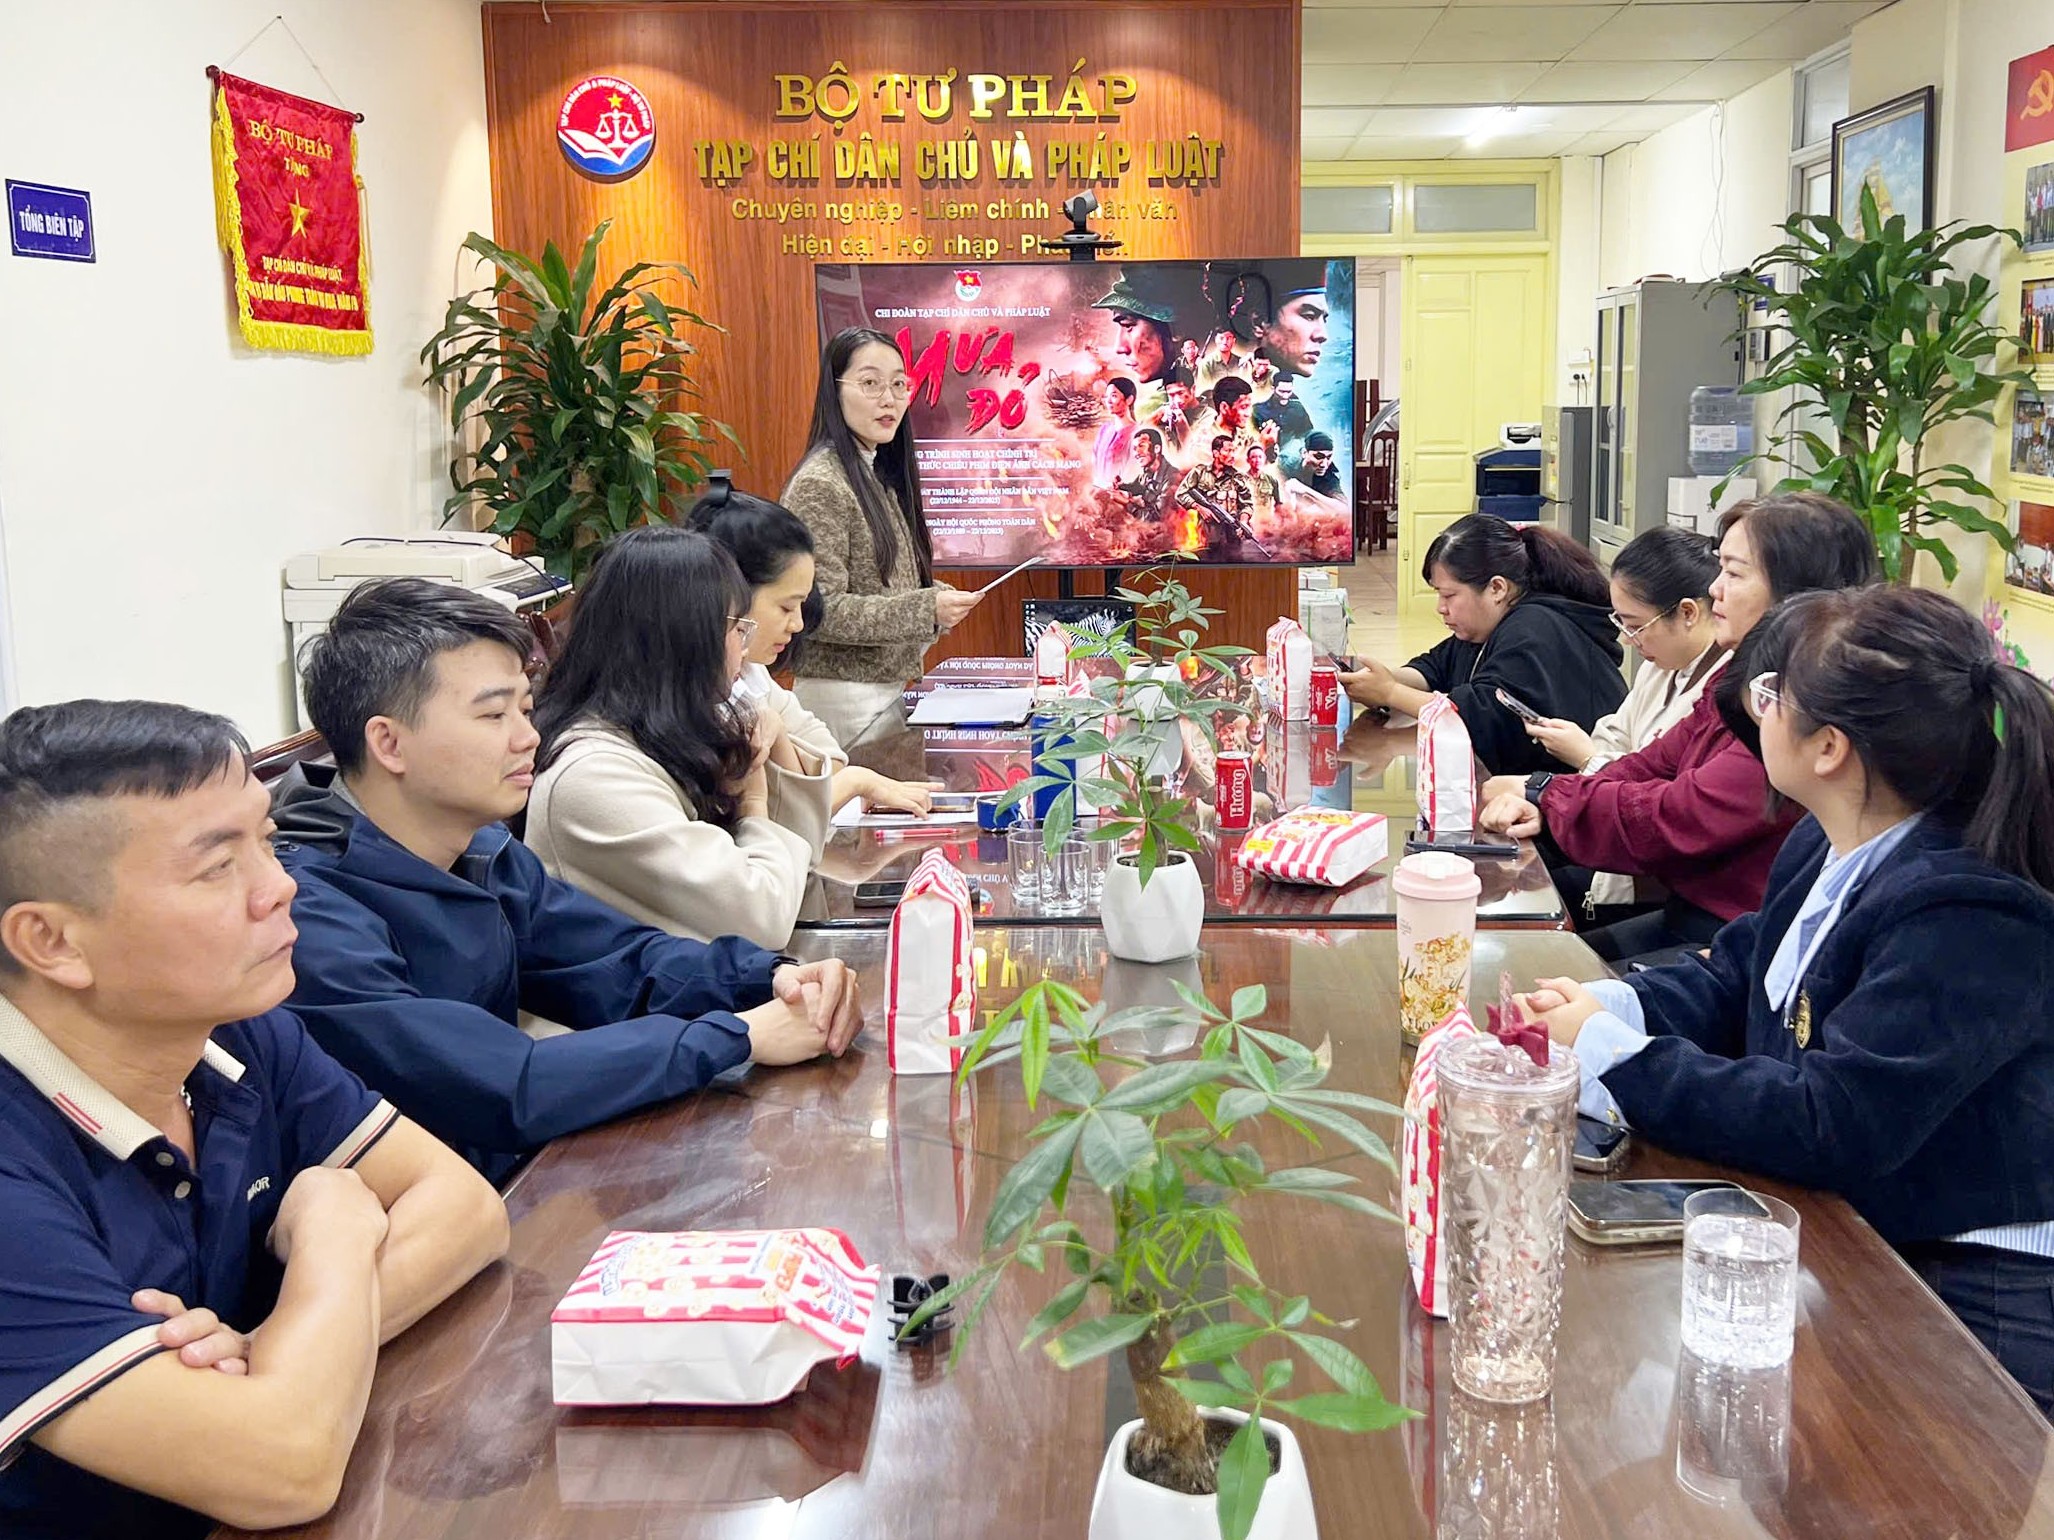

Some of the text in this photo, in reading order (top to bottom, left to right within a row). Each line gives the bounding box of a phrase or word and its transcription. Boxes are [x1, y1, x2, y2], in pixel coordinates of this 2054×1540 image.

[774, 57, 1137, 129] BỘ TƯ PHÁP
[248, 119, 273, 145] BỘ
[295, 135, 333, 160] PHÁP
[694, 126, 1223, 187] TẠP CHÍ DÂN CHỦ VÀ PHÁP LUẬT
[19, 204, 85, 242] TỔNG BIÊN TẬP
[731, 197, 817, 223] Chuyên
[825, 198, 903, 225] nghiệp
[924, 197, 979, 220] Liêm
[986, 197, 1049, 220] chính
[1137, 198, 1178, 220] văn
[783, 233, 833, 259] Hiện
[943, 234, 999, 259] nhập
[875, 306, 1051, 319] CHI ĐOÀN TẠP CHÍ DÂN CHỦ VÀ PHÁP LUẬT
[895, 325, 1015, 409] MƯA
[964, 362, 1041, 436] ĐỎ
[925, 448, 949, 459] TRÌNH
[951, 450, 971, 459] SINH
[972, 450, 995, 460] HOẠT
[996, 448, 1023, 459] CHÍNH
[1024, 449, 1038, 460] TRỊ
[943, 459, 968, 469] CHIẾU
[969, 460, 990, 469] PHIM
[1230, 769, 1246, 817] Hương
